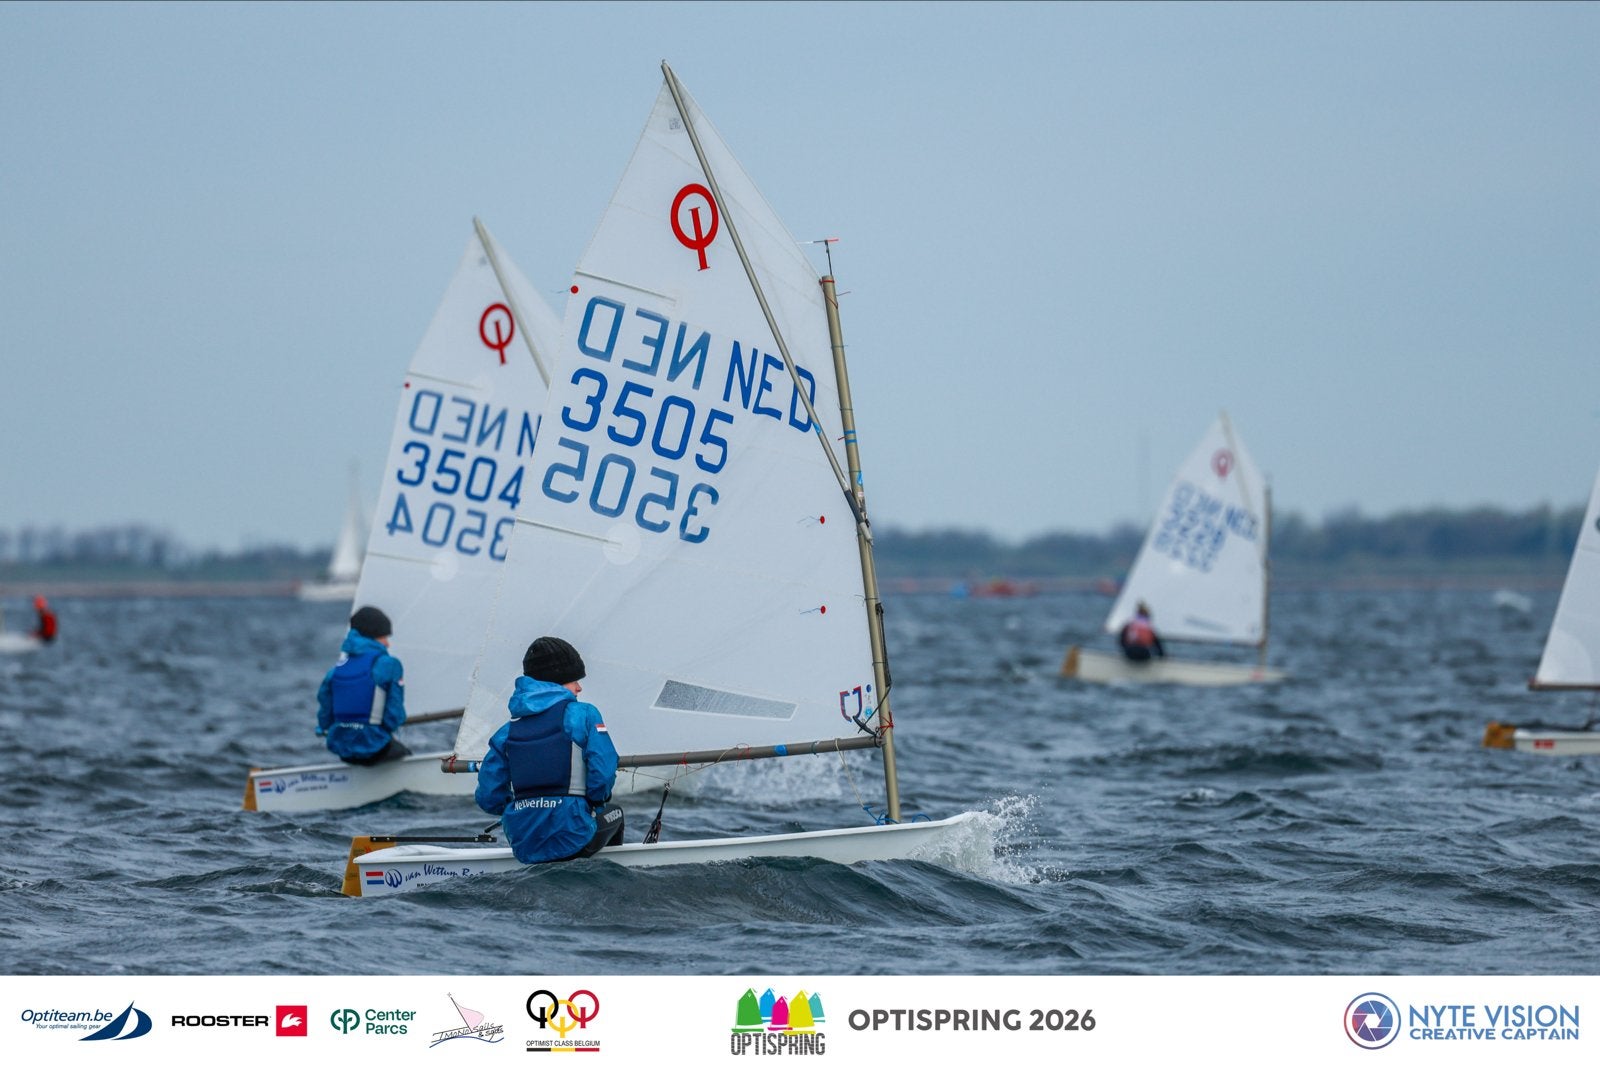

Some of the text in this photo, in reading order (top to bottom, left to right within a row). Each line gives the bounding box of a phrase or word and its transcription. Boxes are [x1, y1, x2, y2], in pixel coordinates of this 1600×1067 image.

[561, 367, 734, 475] 3505
[723, 340, 816, 433] NED
[397, 441, 525, 510] 3504
